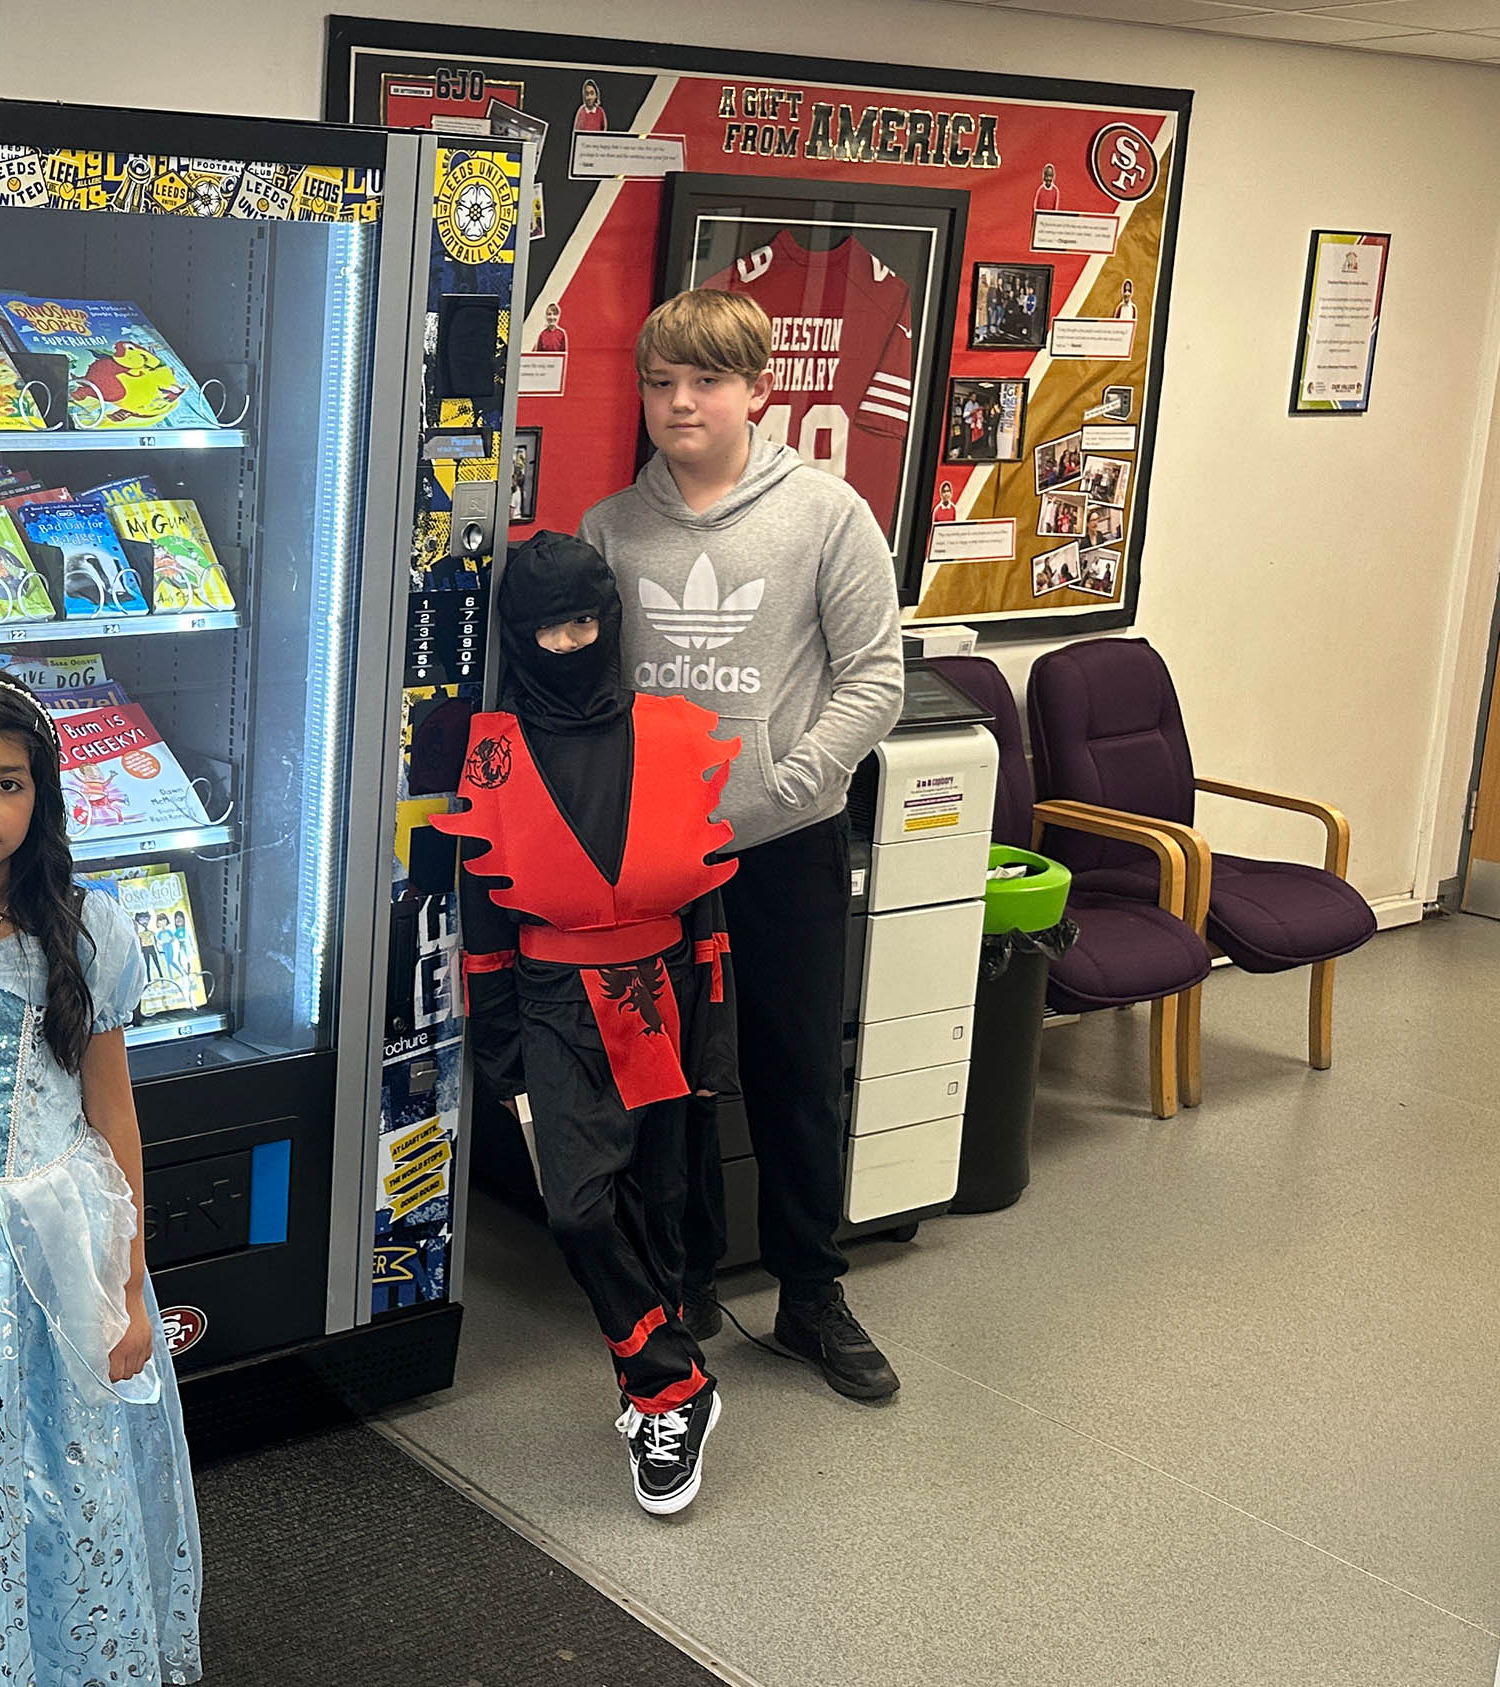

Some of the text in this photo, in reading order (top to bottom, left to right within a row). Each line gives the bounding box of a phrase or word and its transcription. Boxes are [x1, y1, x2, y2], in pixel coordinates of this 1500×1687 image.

[436, 67, 485, 102] 6JO
[718, 86, 804, 121] A GIFT
[723, 122, 800, 157] FROM
[805, 102, 1002, 168] AMERICA
[197, 161, 240, 173] FOOTBAL
[156, 183, 186, 199] LEEDS
[303, 176, 340, 203] LEEDS
[442, 162, 474, 200] LEEDS
[479, 161, 511, 203] UNITED
[246, 179, 288, 210] LEEDS
[439, 220, 509, 262] FOOTBALL CLUB
[771, 317, 843, 351] BEESTON
[101, 480, 147, 506] JACK
[38, 521, 62, 534] Bad
[88, 519, 104, 529] for
[126, 517, 151, 540] Mr
[422, 600, 428, 609] 1
[465, 597, 475, 607] 6
[420, 614, 430, 623] 2
[464, 611, 473, 620] 7
[12, 631, 26, 640] 22
[106, 624, 120, 634] 24
[419, 628, 429, 638] 3
[463, 625, 473, 634] 8
[418, 641, 428, 651] 4
[462, 638, 472, 648] 9
[417, 655, 428, 665] 5
[462, 652, 472, 662] 0
[57, 666, 96, 688] DOG
[635, 655, 761, 693] adidas
[65, 713, 125, 740] Bum is
[71, 728, 148, 762] CHEEKY!
[392, 1146, 400, 1156] AT
[401, 1135, 420, 1151] LEAST
[401, 1162, 423, 1180] WORLD
[423, 1150, 443, 1167] STOPS
